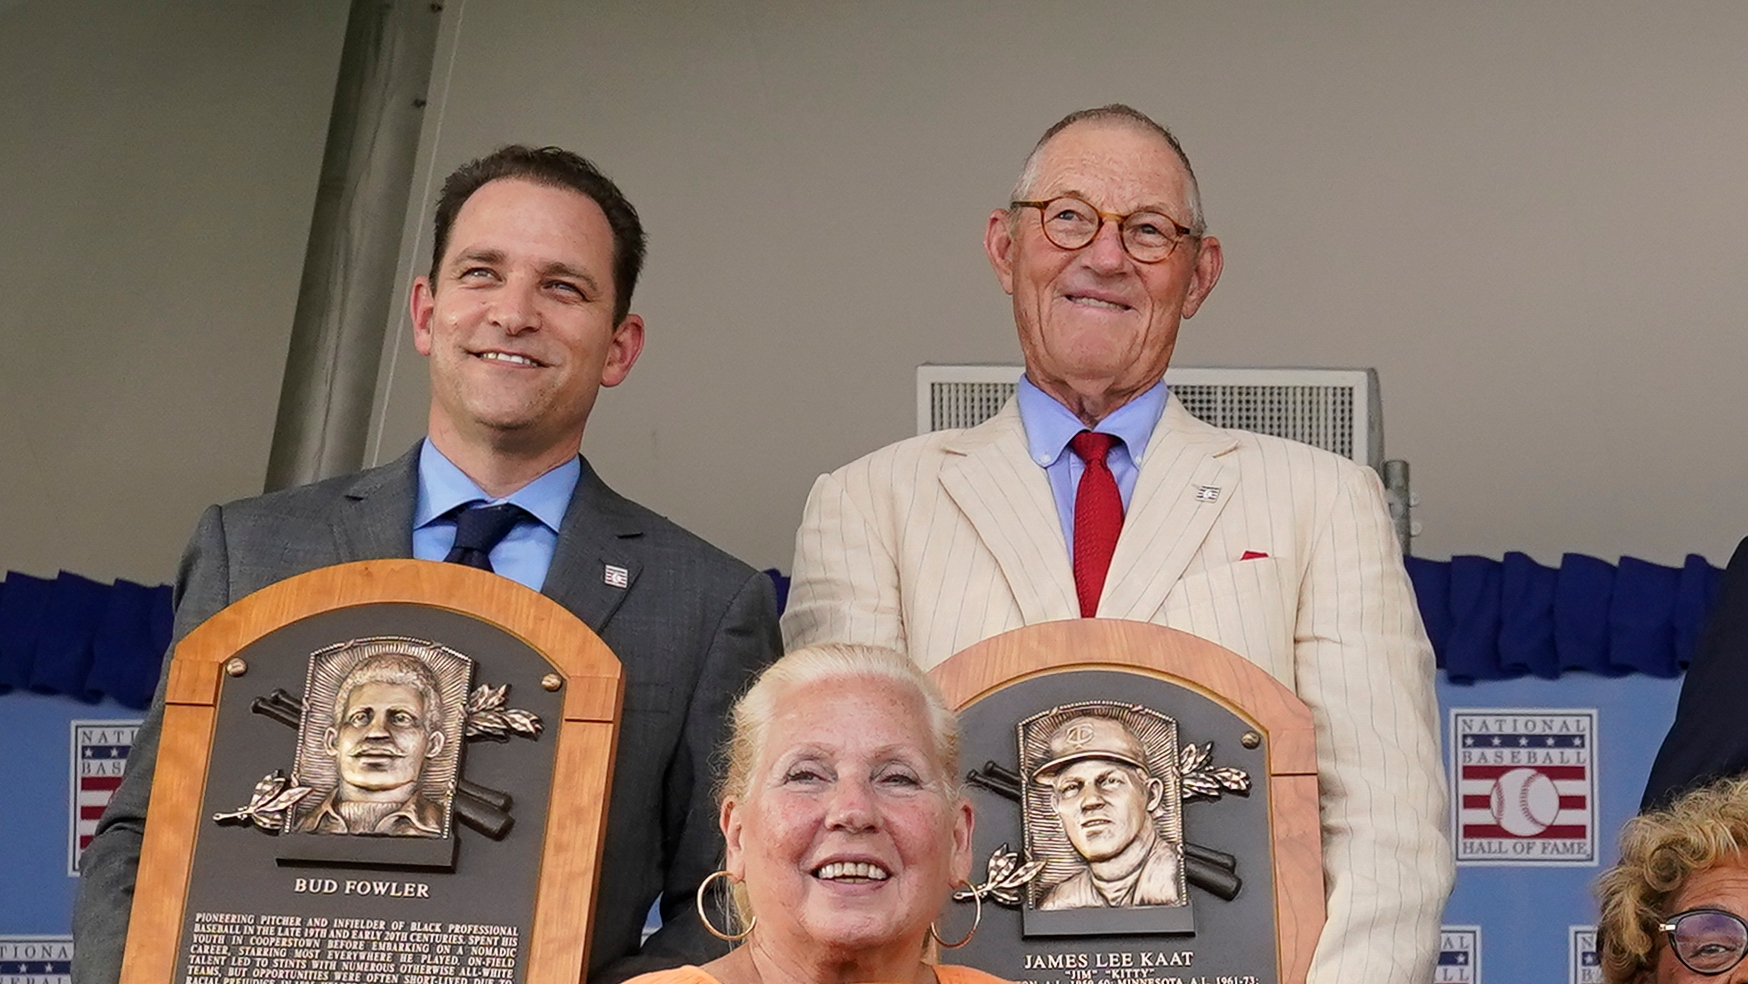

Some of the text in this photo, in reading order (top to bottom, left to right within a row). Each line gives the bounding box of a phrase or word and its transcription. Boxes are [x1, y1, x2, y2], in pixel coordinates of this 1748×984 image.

[1462, 718, 1586, 734] NATIONAL
[81, 730, 137, 744] NATI
[1462, 750, 1587, 765] BASEBALL
[1462, 840, 1587, 855] HALL OF FAME
[294, 878, 431, 898] BUD FOWLER
[195, 913, 519, 935] PIONEERING PITCHER AND INFIELDER OF BLACK PROFESSIONAL
[0, 946, 69, 959] TIONA
[1024, 952, 1194, 969] JAMES LEE KAAT
